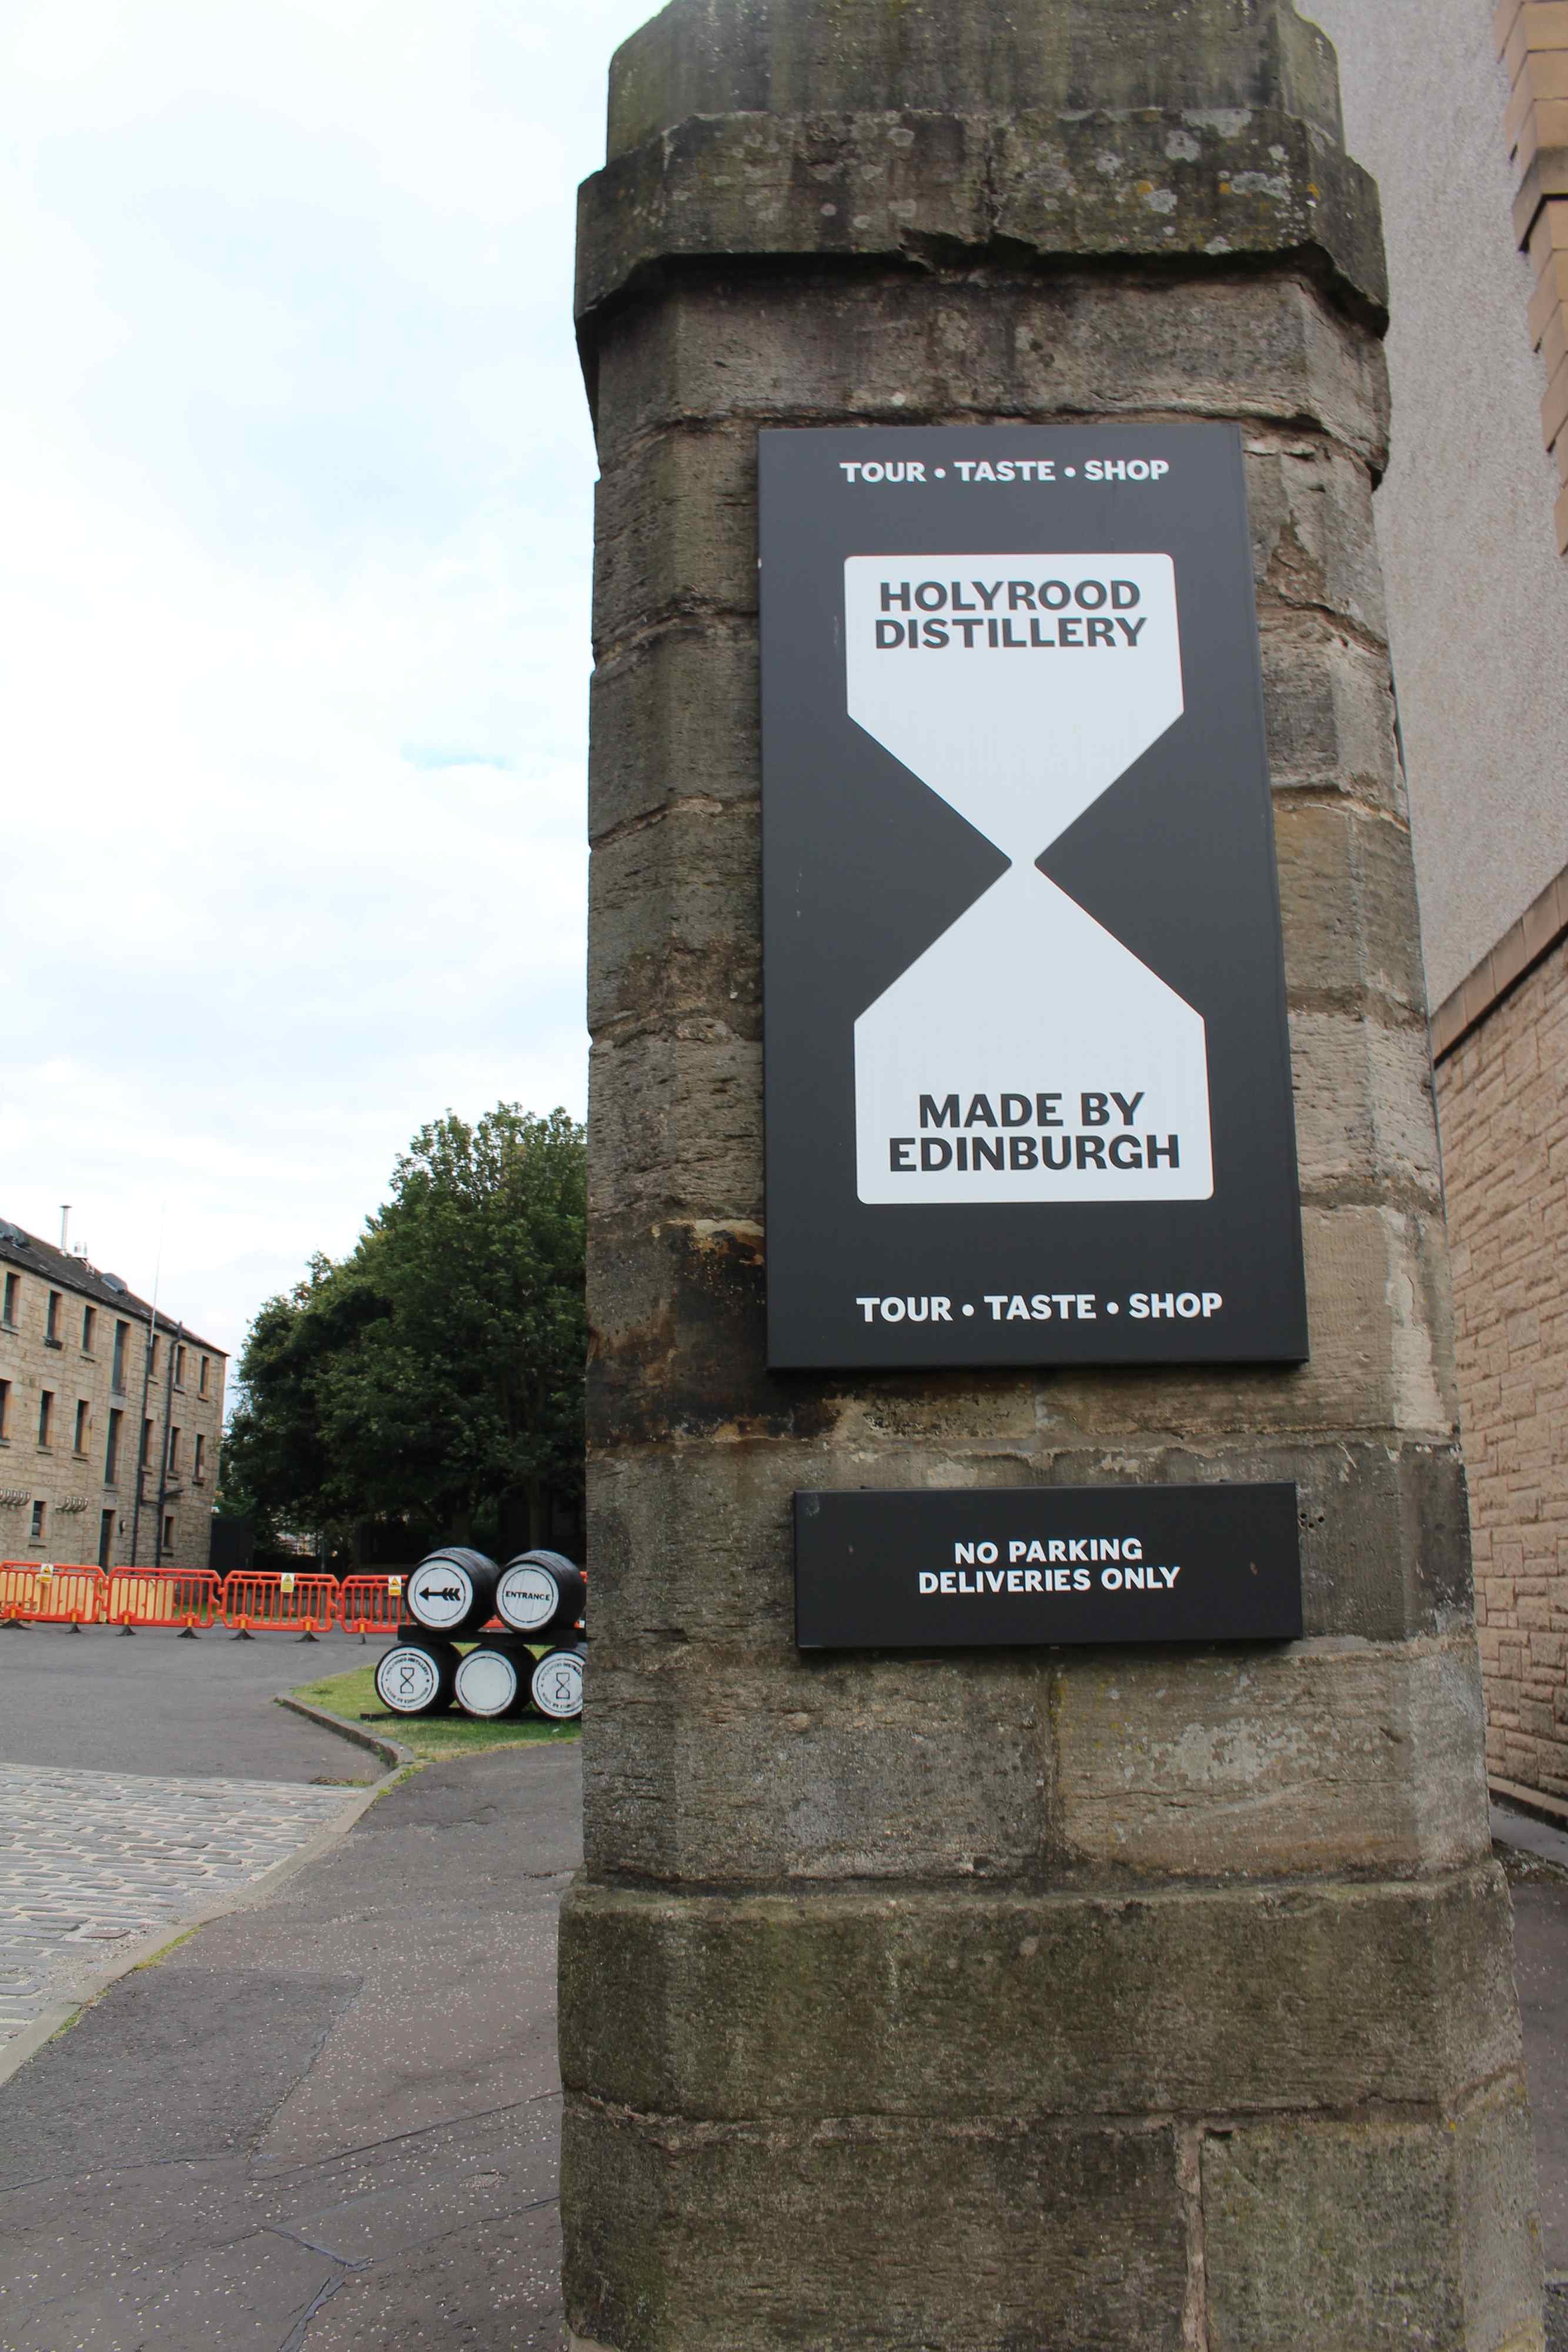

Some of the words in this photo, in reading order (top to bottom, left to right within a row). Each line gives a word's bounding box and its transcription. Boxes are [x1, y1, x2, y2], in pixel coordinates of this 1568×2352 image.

[839, 462, 927, 483] TOUR
[954, 460, 1056, 482] TASTE
[1084, 459, 1169, 481] SHOP
[880, 580, 1141, 612] HOLYROOD
[875, 617, 1147, 649] DISTILLERY
[919, 1093, 1064, 1128] MADE
[1081, 1092, 1145, 1127] BY
[890, 1134, 1180, 1172] EDINBURGH
[855, 1296, 953, 1322] TOUR
[984, 1294, 1096, 1320] TASTE
[1128, 1292, 1222, 1318] SHOP
[955, 1542, 998, 1564] NO
[1009, 1538, 1142, 1562] PARKING
[919, 1568, 1091, 1593] DELIVERIES
[1101, 1566, 1181, 1590] ONLY
[506, 1591, 550, 1601] ENTRANCE
